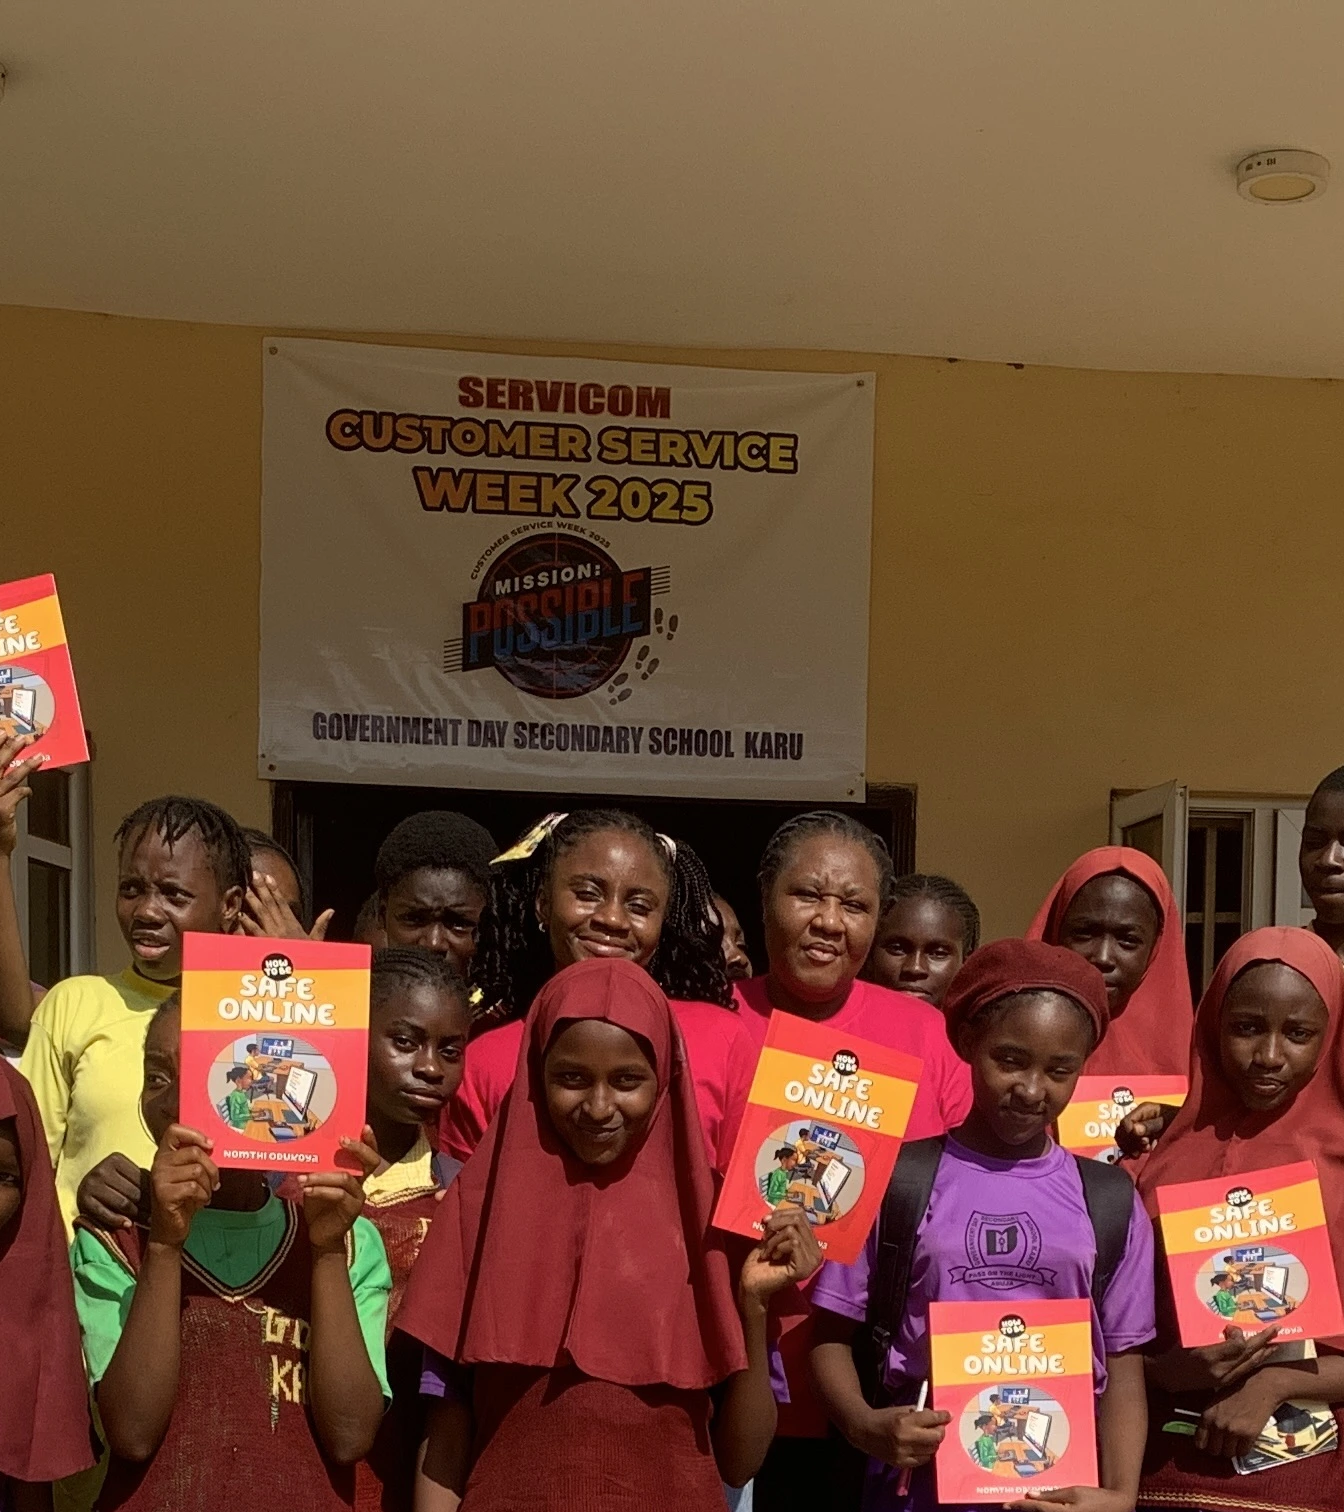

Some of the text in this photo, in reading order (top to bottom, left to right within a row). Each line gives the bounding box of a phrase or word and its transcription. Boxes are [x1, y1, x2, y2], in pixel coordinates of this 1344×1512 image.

[458, 376, 672, 419] SERVICOM
[326, 408, 799, 474] CUSTOMER SERVICE
[413, 466, 714, 526] WEEK 2025
[470, 521, 612, 580] CUSTOMER SERVICE WEEK 2025
[495, 562, 602, 596] MISSION:
[468, 572, 645, 664] POSSIBLE
[312, 711, 805, 762] GOVERNMENT DAY SECONDARY SCHOOL KARU
[264, 967, 291, 976] TO BE
[265, 959, 288, 968] HOW
[239, 974, 315, 1001] SAFE
[218, 997, 336, 1027] ONLINE
[834, 1062, 846, 1071] TO
[836, 1053, 856, 1065] HOW
[808, 1063, 873, 1102] SAFE
[784, 1080, 884, 1129] ONLINE
[1210, 1198, 1276, 1224] SAFE
[1194, 1213, 1297, 1244] ONLINE
[981, 1333, 1046, 1354] SAFE
[963, 1354, 1066, 1376] ONLINE
